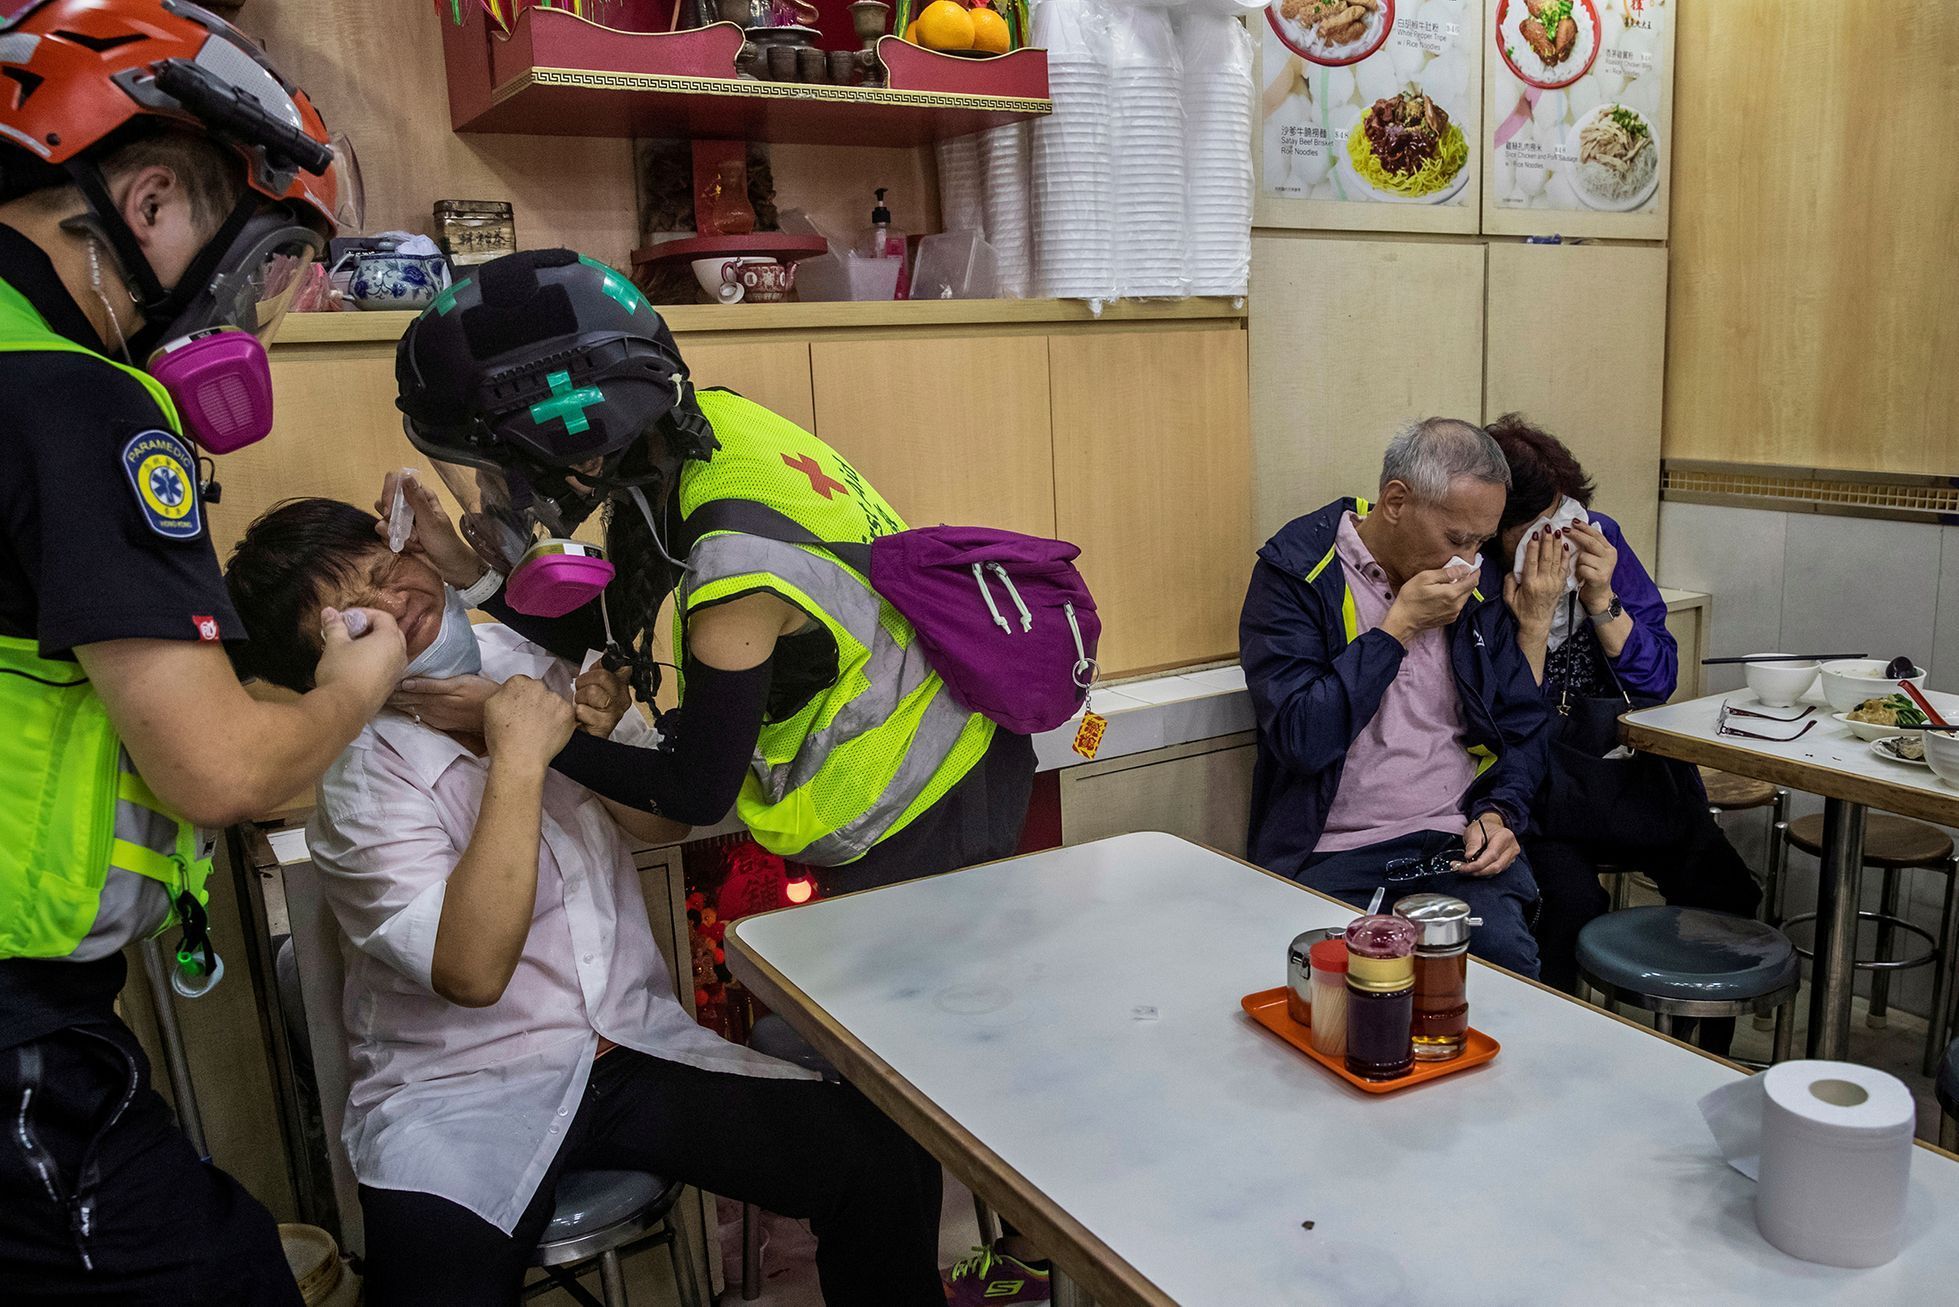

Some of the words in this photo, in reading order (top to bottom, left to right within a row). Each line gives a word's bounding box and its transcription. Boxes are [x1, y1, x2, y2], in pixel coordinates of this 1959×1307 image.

[1414, 31, 1432, 41] Pepper
[1406, 40, 1419, 48] Rice
[1419, 41, 1441, 51] Noodles
[1281, 136, 1298, 146] Satay
[1299, 137, 1313, 146] Beef
[1294, 148, 1319, 156] Noodles
[128, 440, 191, 467] PARAMEDIC
